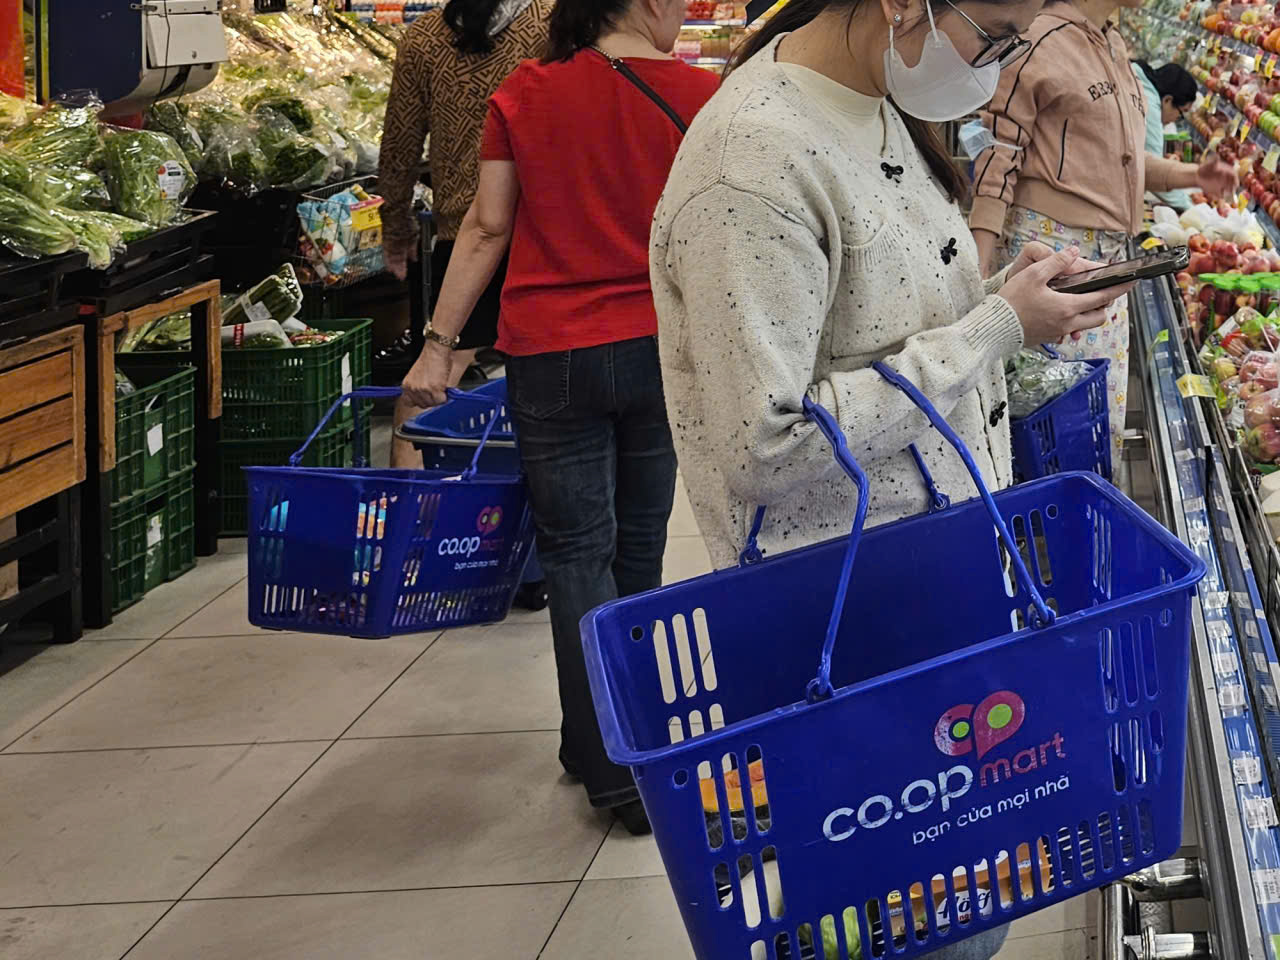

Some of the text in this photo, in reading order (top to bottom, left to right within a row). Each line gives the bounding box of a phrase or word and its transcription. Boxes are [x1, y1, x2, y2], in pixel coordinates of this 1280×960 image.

[912, 771, 1070, 845] bạn của mọi nhà
